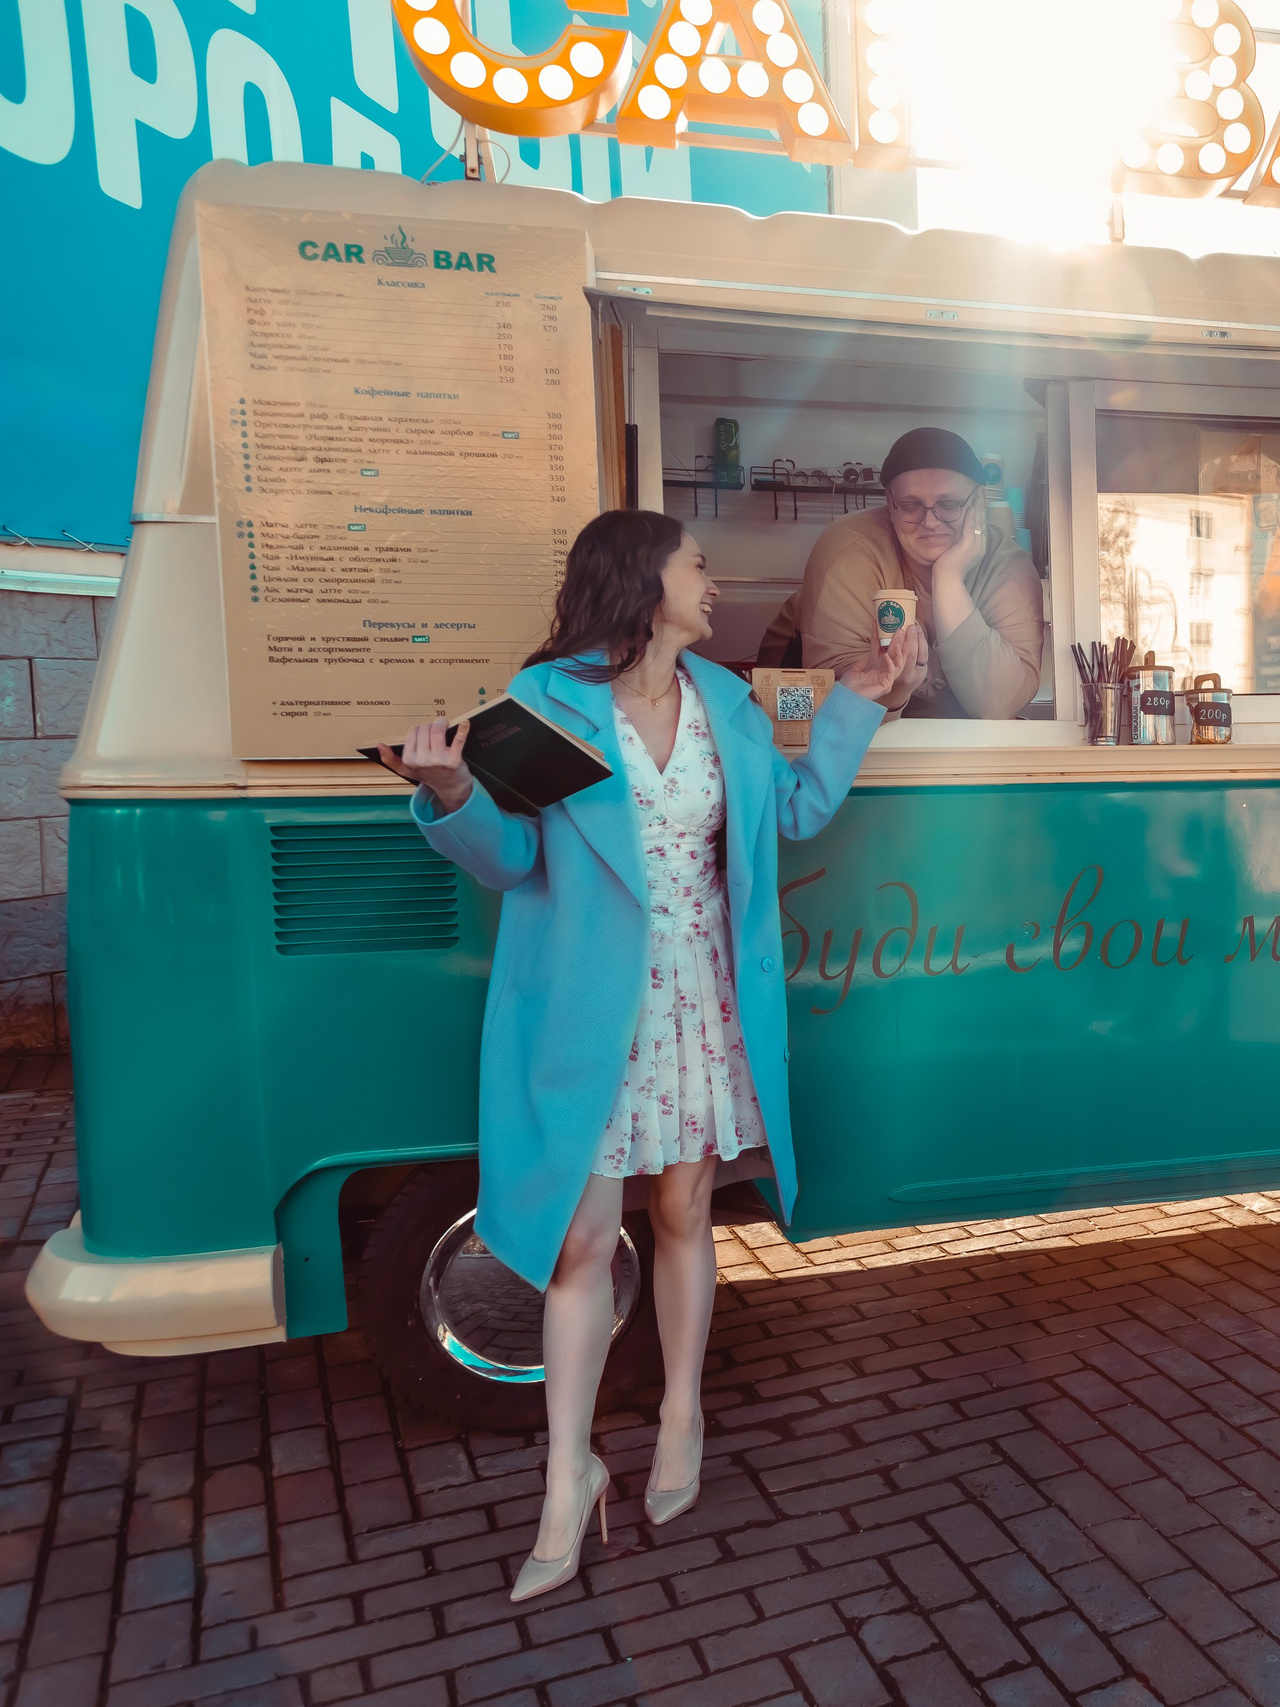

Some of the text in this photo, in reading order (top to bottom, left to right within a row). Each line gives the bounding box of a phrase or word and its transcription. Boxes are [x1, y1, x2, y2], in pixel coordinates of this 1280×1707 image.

[298, 240, 497, 273] CAR BAR
[377, 278, 425, 288] Классика
[249, 330, 292, 338] Эспрессо
[354, 387, 459, 399] Кофейные напитки
[348, 426, 390, 434] капучино
[313, 455, 348, 464] фраппе
[459, 451, 498, 459] крошкой
[430, 508, 472, 516] напитки
[259, 521, 288, 529] Матча
[375, 546, 412, 554] травами
[349, 556, 402, 565] облепихой»
[319, 576, 376, 585] смородиной
[362, 619, 415, 630] Перекусы
[433, 622, 476, 631] десерты
[267, 634, 305, 642] Горячий
[268, 656, 318, 665] Вафельная
[779, 866, 971, 1015] буди
[1004, 864, 1195, 973] свои
